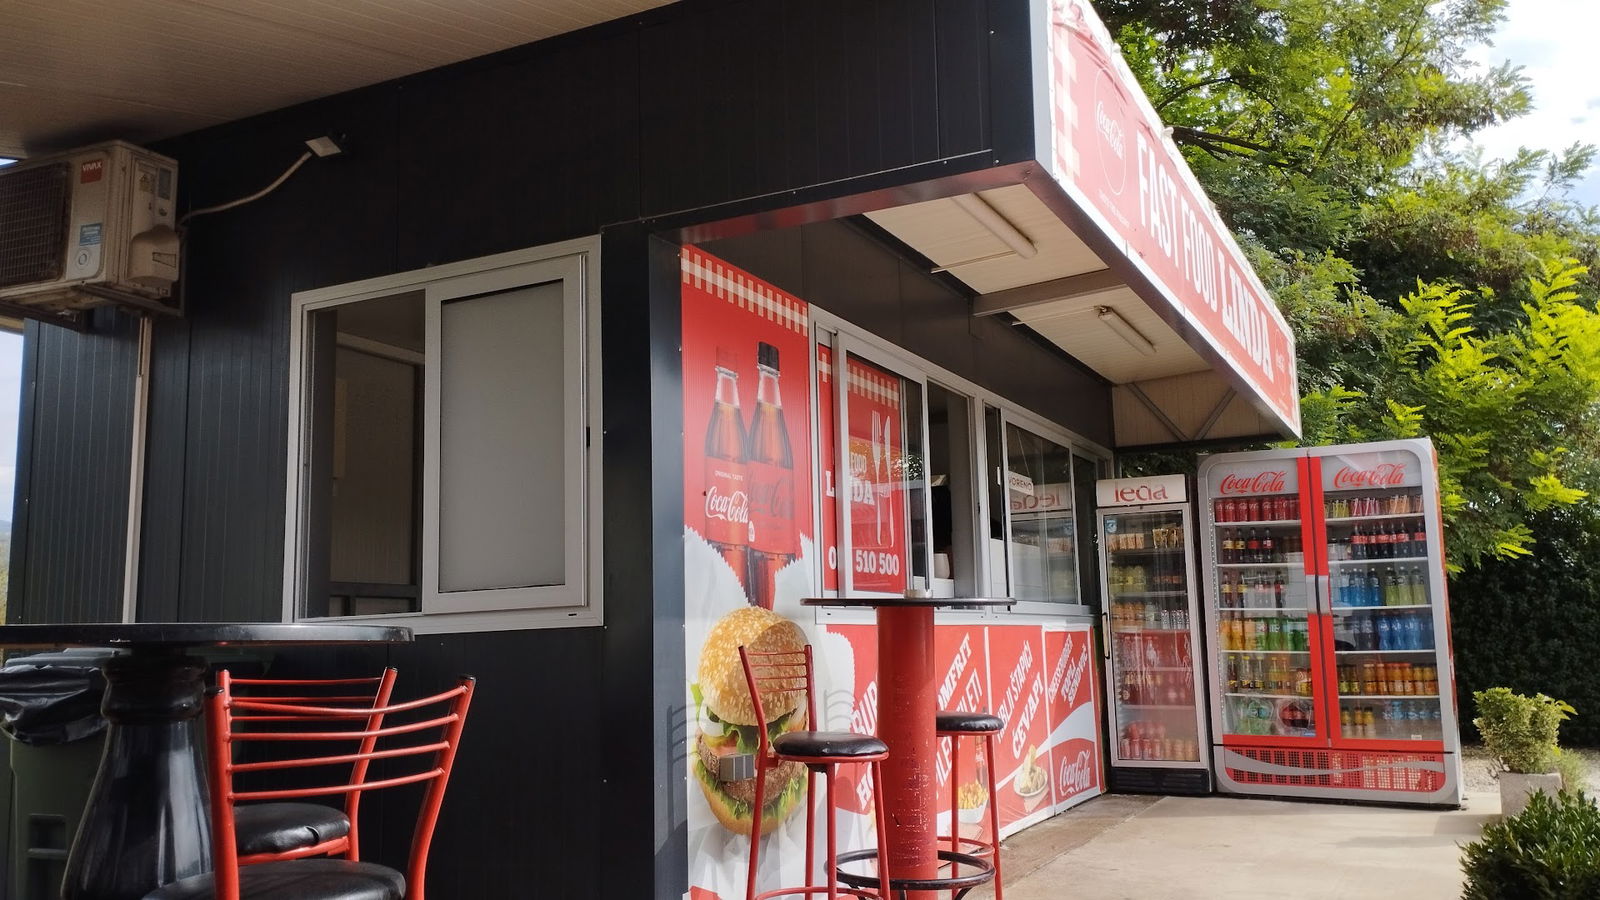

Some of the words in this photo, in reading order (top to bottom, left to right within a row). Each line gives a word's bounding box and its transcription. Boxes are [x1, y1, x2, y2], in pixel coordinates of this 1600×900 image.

[82, 161, 102, 172] VIVAX
[1137, 131, 1179, 267] FAST
[1181, 194, 1217, 313] FOOD
[1217, 248, 1275, 384] LINDA
[1220, 471, 1288, 495] Coca-Cola
[1333, 463, 1407, 489] Coca-Cola
[705, 486, 749, 524] Coca-Cola
[855, 549, 877, 574] 510
[879, 552, 900, 577] 500
[937, 632, 973, 712] MFRIT
[1059, 749, 1091, 797] Coca-Cola
